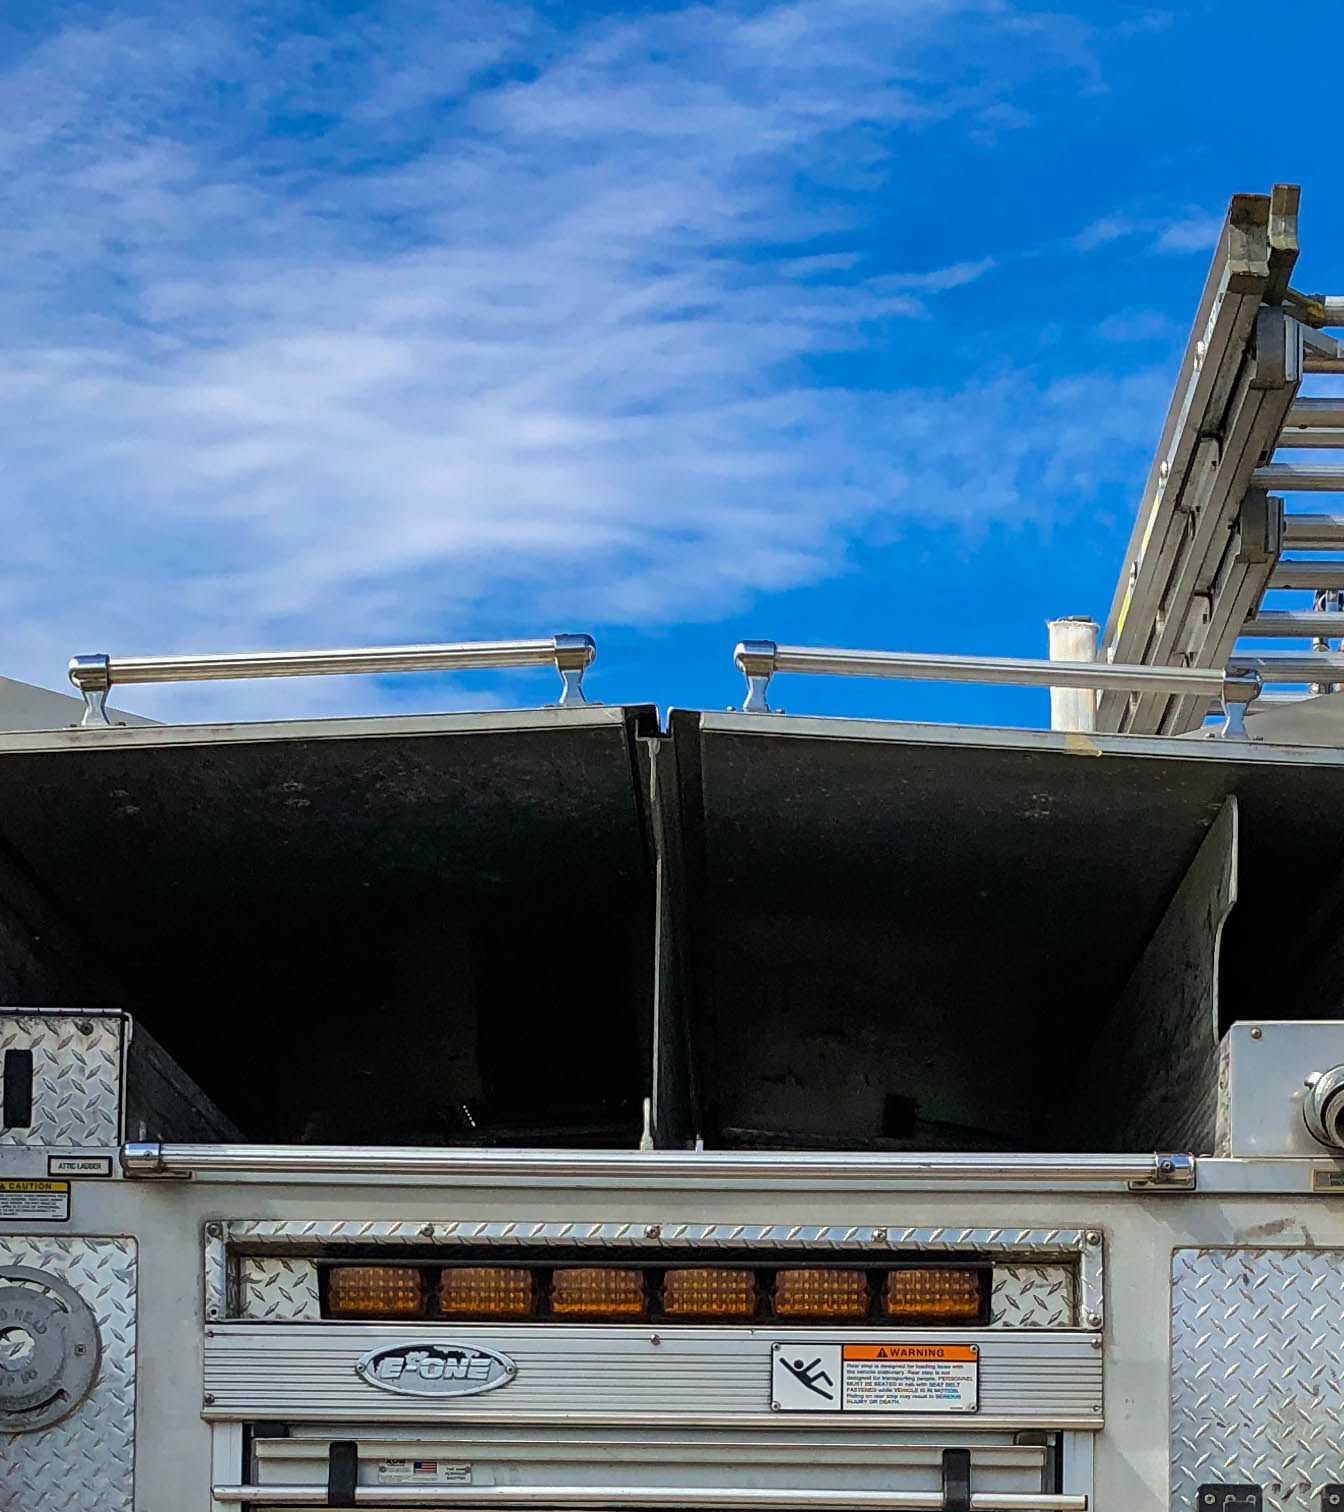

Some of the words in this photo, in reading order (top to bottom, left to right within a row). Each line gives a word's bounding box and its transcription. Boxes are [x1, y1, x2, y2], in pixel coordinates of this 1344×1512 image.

[58, 1162, 75, 1170] ATTIC
[76, 1162, 102, 1170] LADDER
[889, 1348, 945, 1358] WARNING
[380, 1357, 492, 1381] E-ONE
